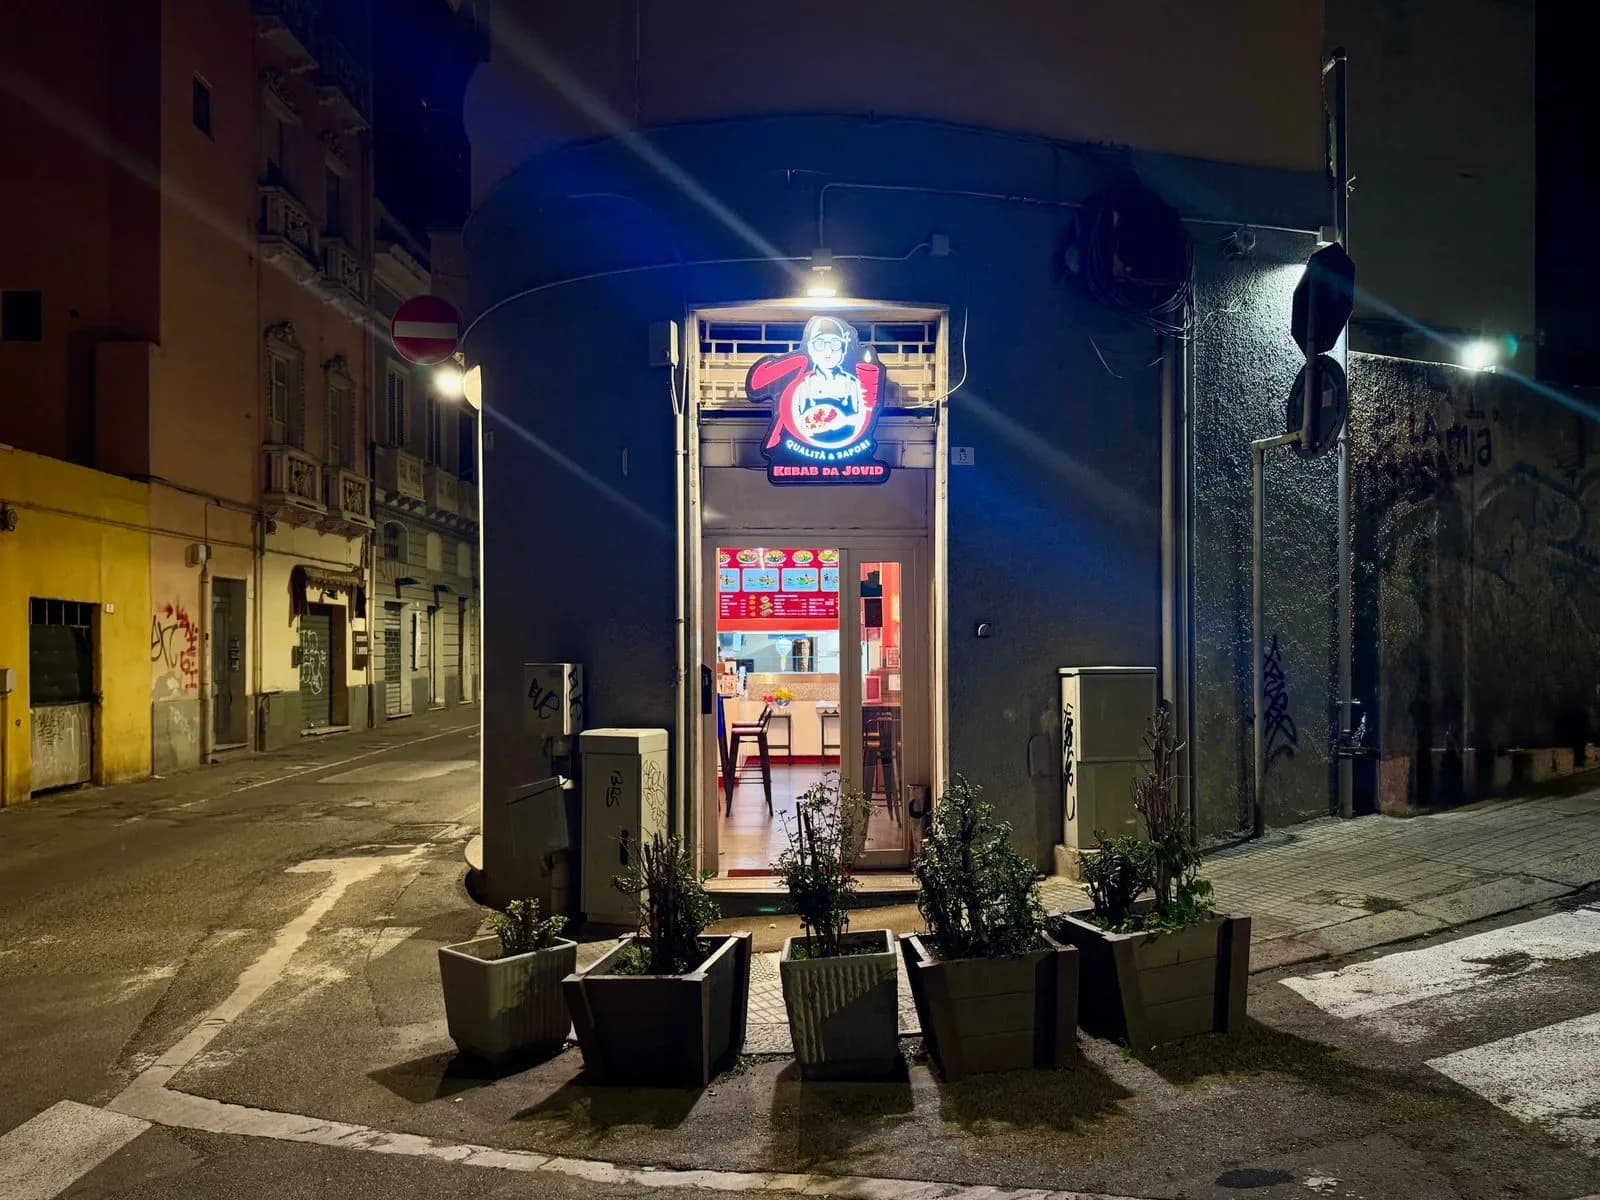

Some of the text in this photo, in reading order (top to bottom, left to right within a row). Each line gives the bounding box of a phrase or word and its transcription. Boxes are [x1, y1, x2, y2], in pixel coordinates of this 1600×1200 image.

[786, 439, 826, 460] QUALITÀ
[837, 439, 871, 460] SAPORI
[773, 466, 819, 476] KEBAB
[842, 465, 884, 476] JOVID
